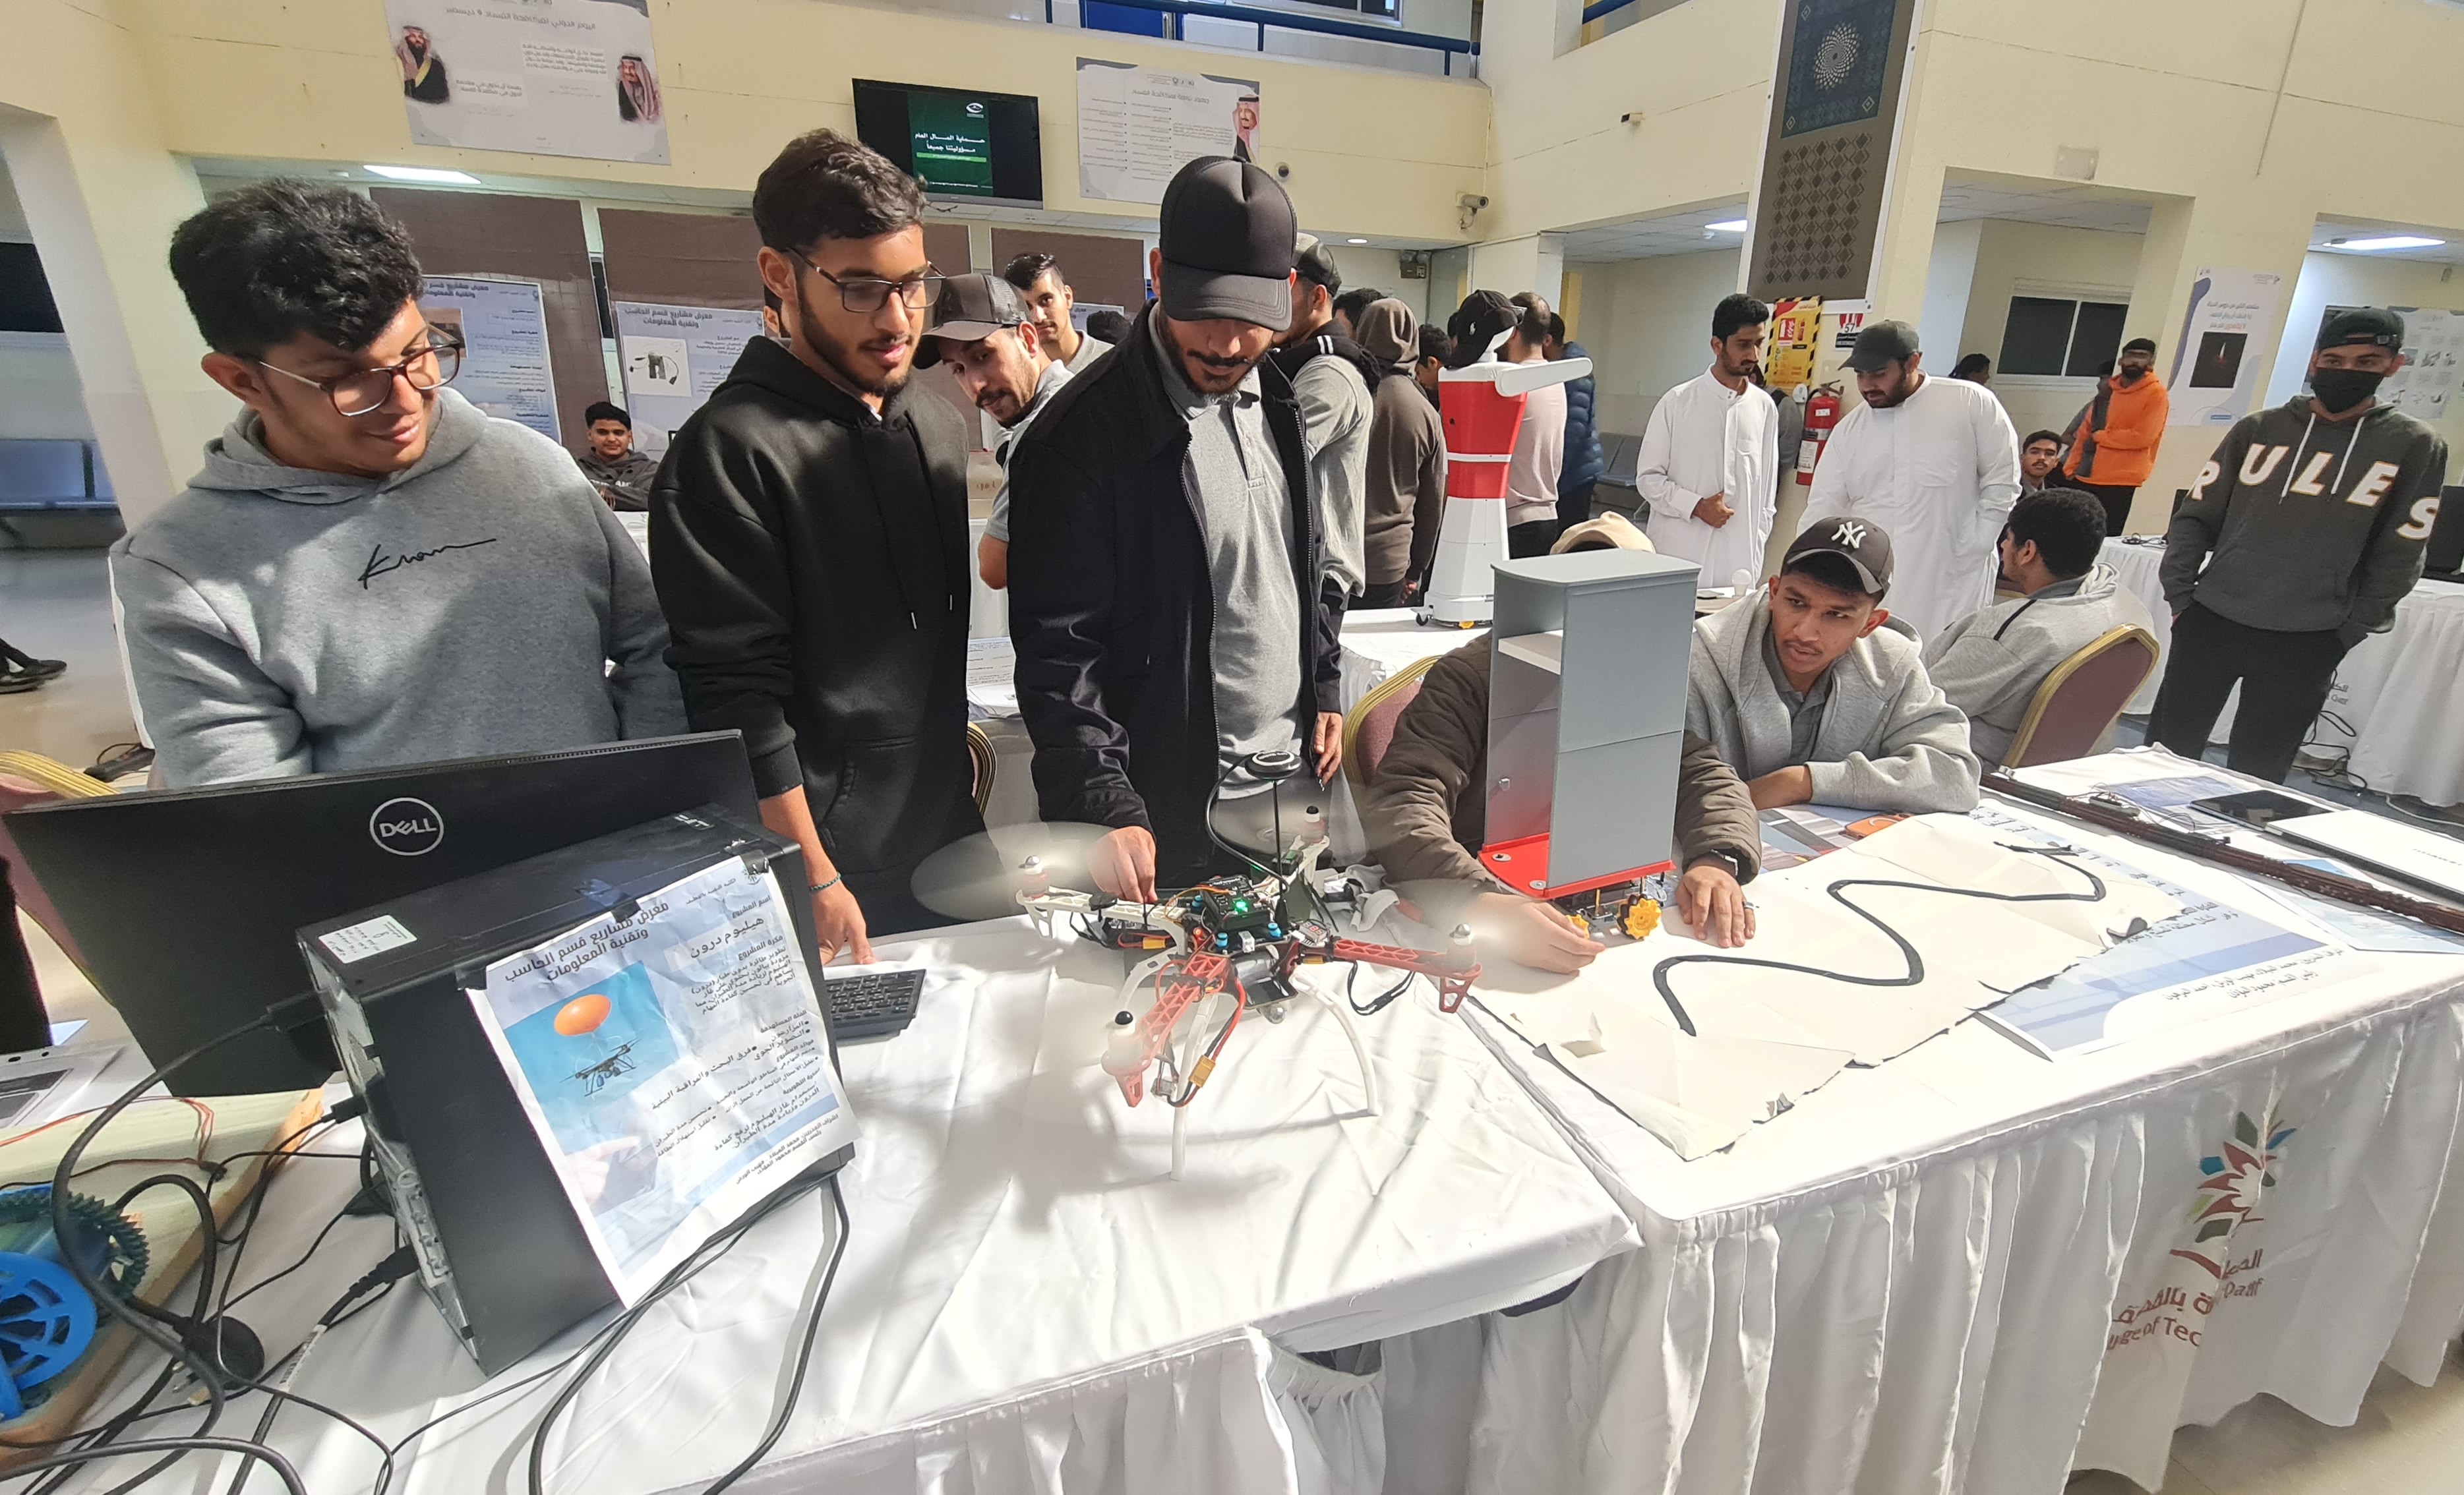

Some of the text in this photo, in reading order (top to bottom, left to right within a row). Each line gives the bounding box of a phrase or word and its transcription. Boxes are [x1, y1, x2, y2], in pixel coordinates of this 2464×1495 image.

[956, 134, 985, 143] حماية
[379, 818, 437, 838] DELL
[634, 903, 669, 925] معرض
[732, 895, 771, 919] اسم المشروع
[558, 937, 587, 962] قسم
[691, 918, 764, 958] هيليوم درون
[547, 929, 649, 982] وتقنية المعلومات
[738, 941, 766, 961] المشروع
[506, 952, 555, 981] الحاسب
